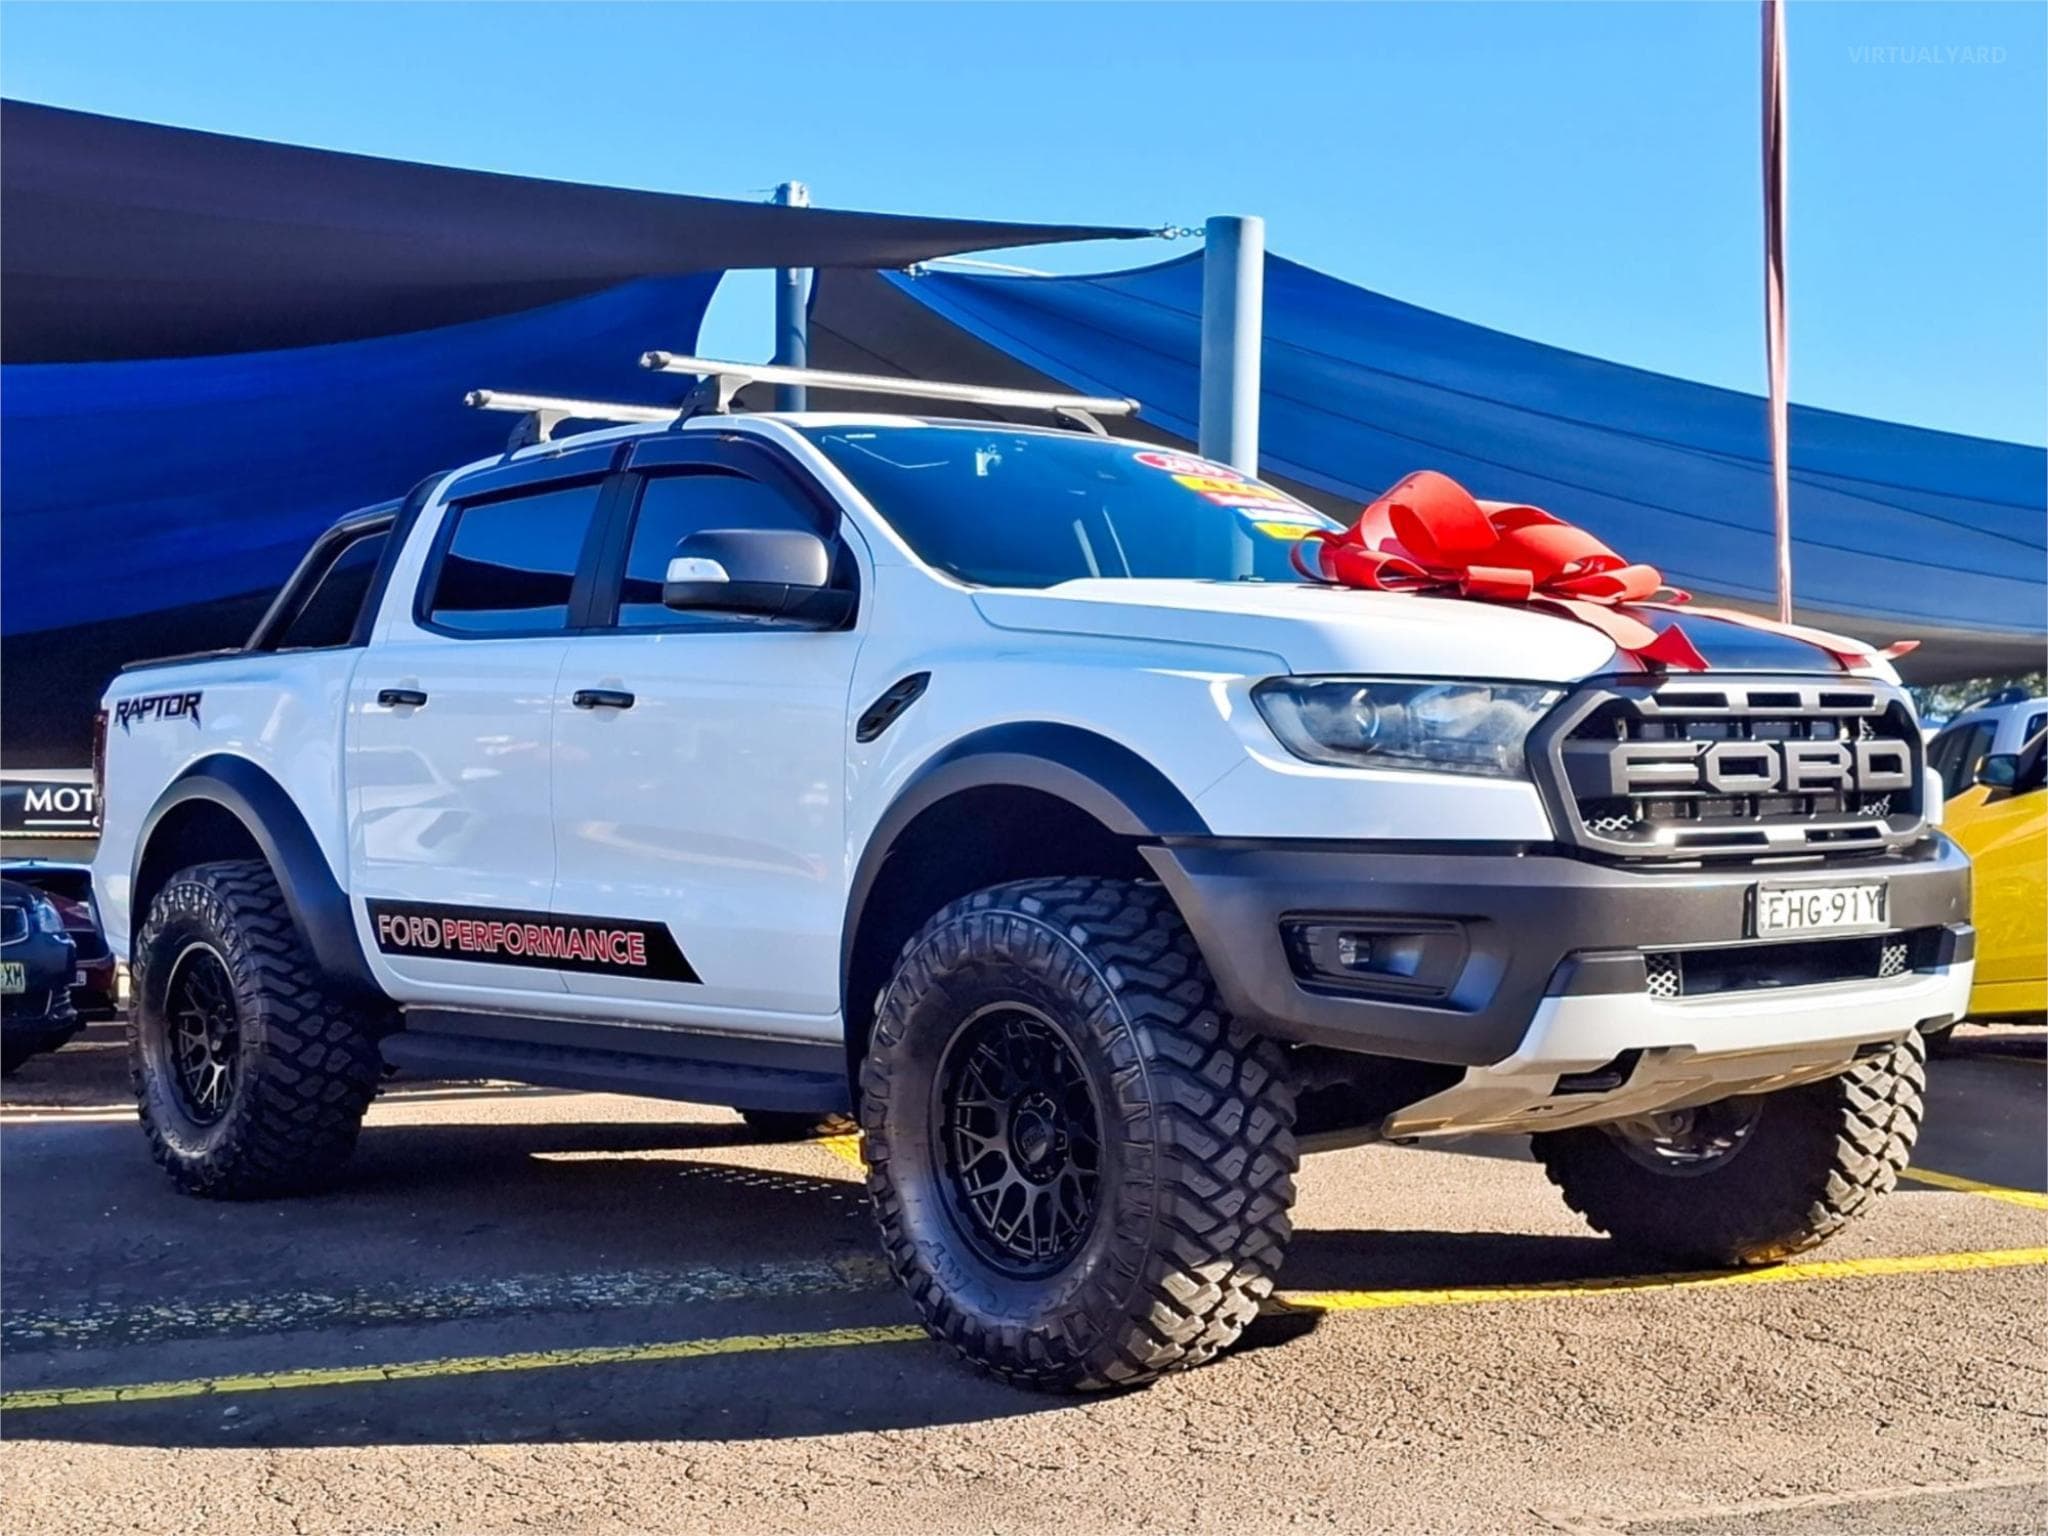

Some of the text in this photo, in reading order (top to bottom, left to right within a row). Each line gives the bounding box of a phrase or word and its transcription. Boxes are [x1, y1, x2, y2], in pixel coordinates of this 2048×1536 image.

[114, 691, 203, 736] RAPTOR
[1610, 740, 1913, 795] FORD
[378, 914, 647, 965] FORD PERFORMANCE
